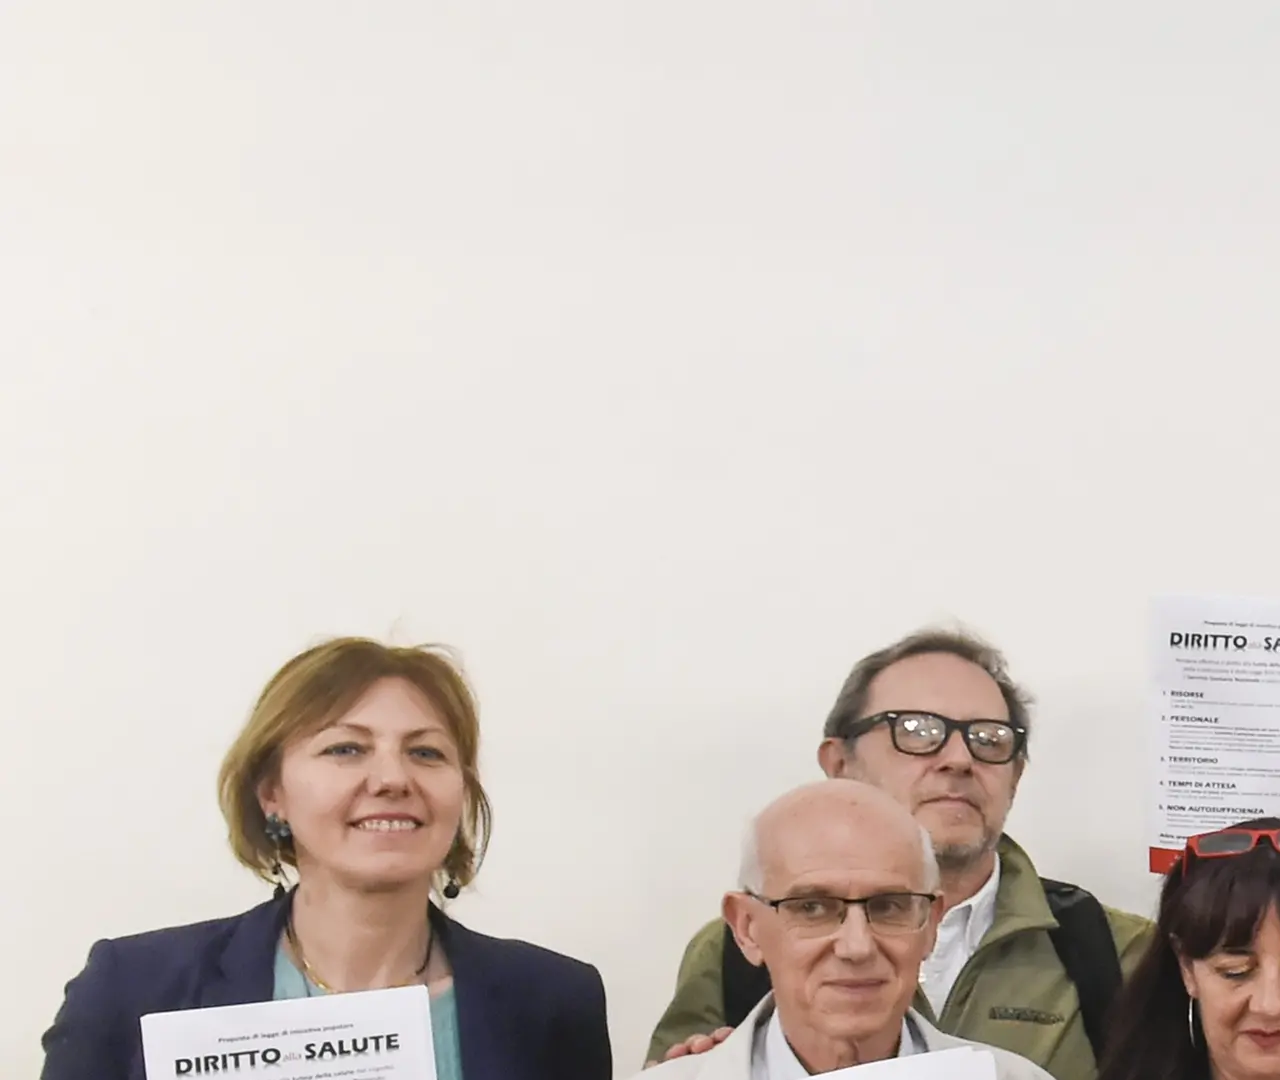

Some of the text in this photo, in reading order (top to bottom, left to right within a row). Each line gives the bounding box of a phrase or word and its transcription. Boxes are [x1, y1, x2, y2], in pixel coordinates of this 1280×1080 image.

[1169, 632, 1248, 648] DIRITTO
[176, 1048, 281, 1076] DIRITTO
[304, 1033, 400, 1060] SALUTE
